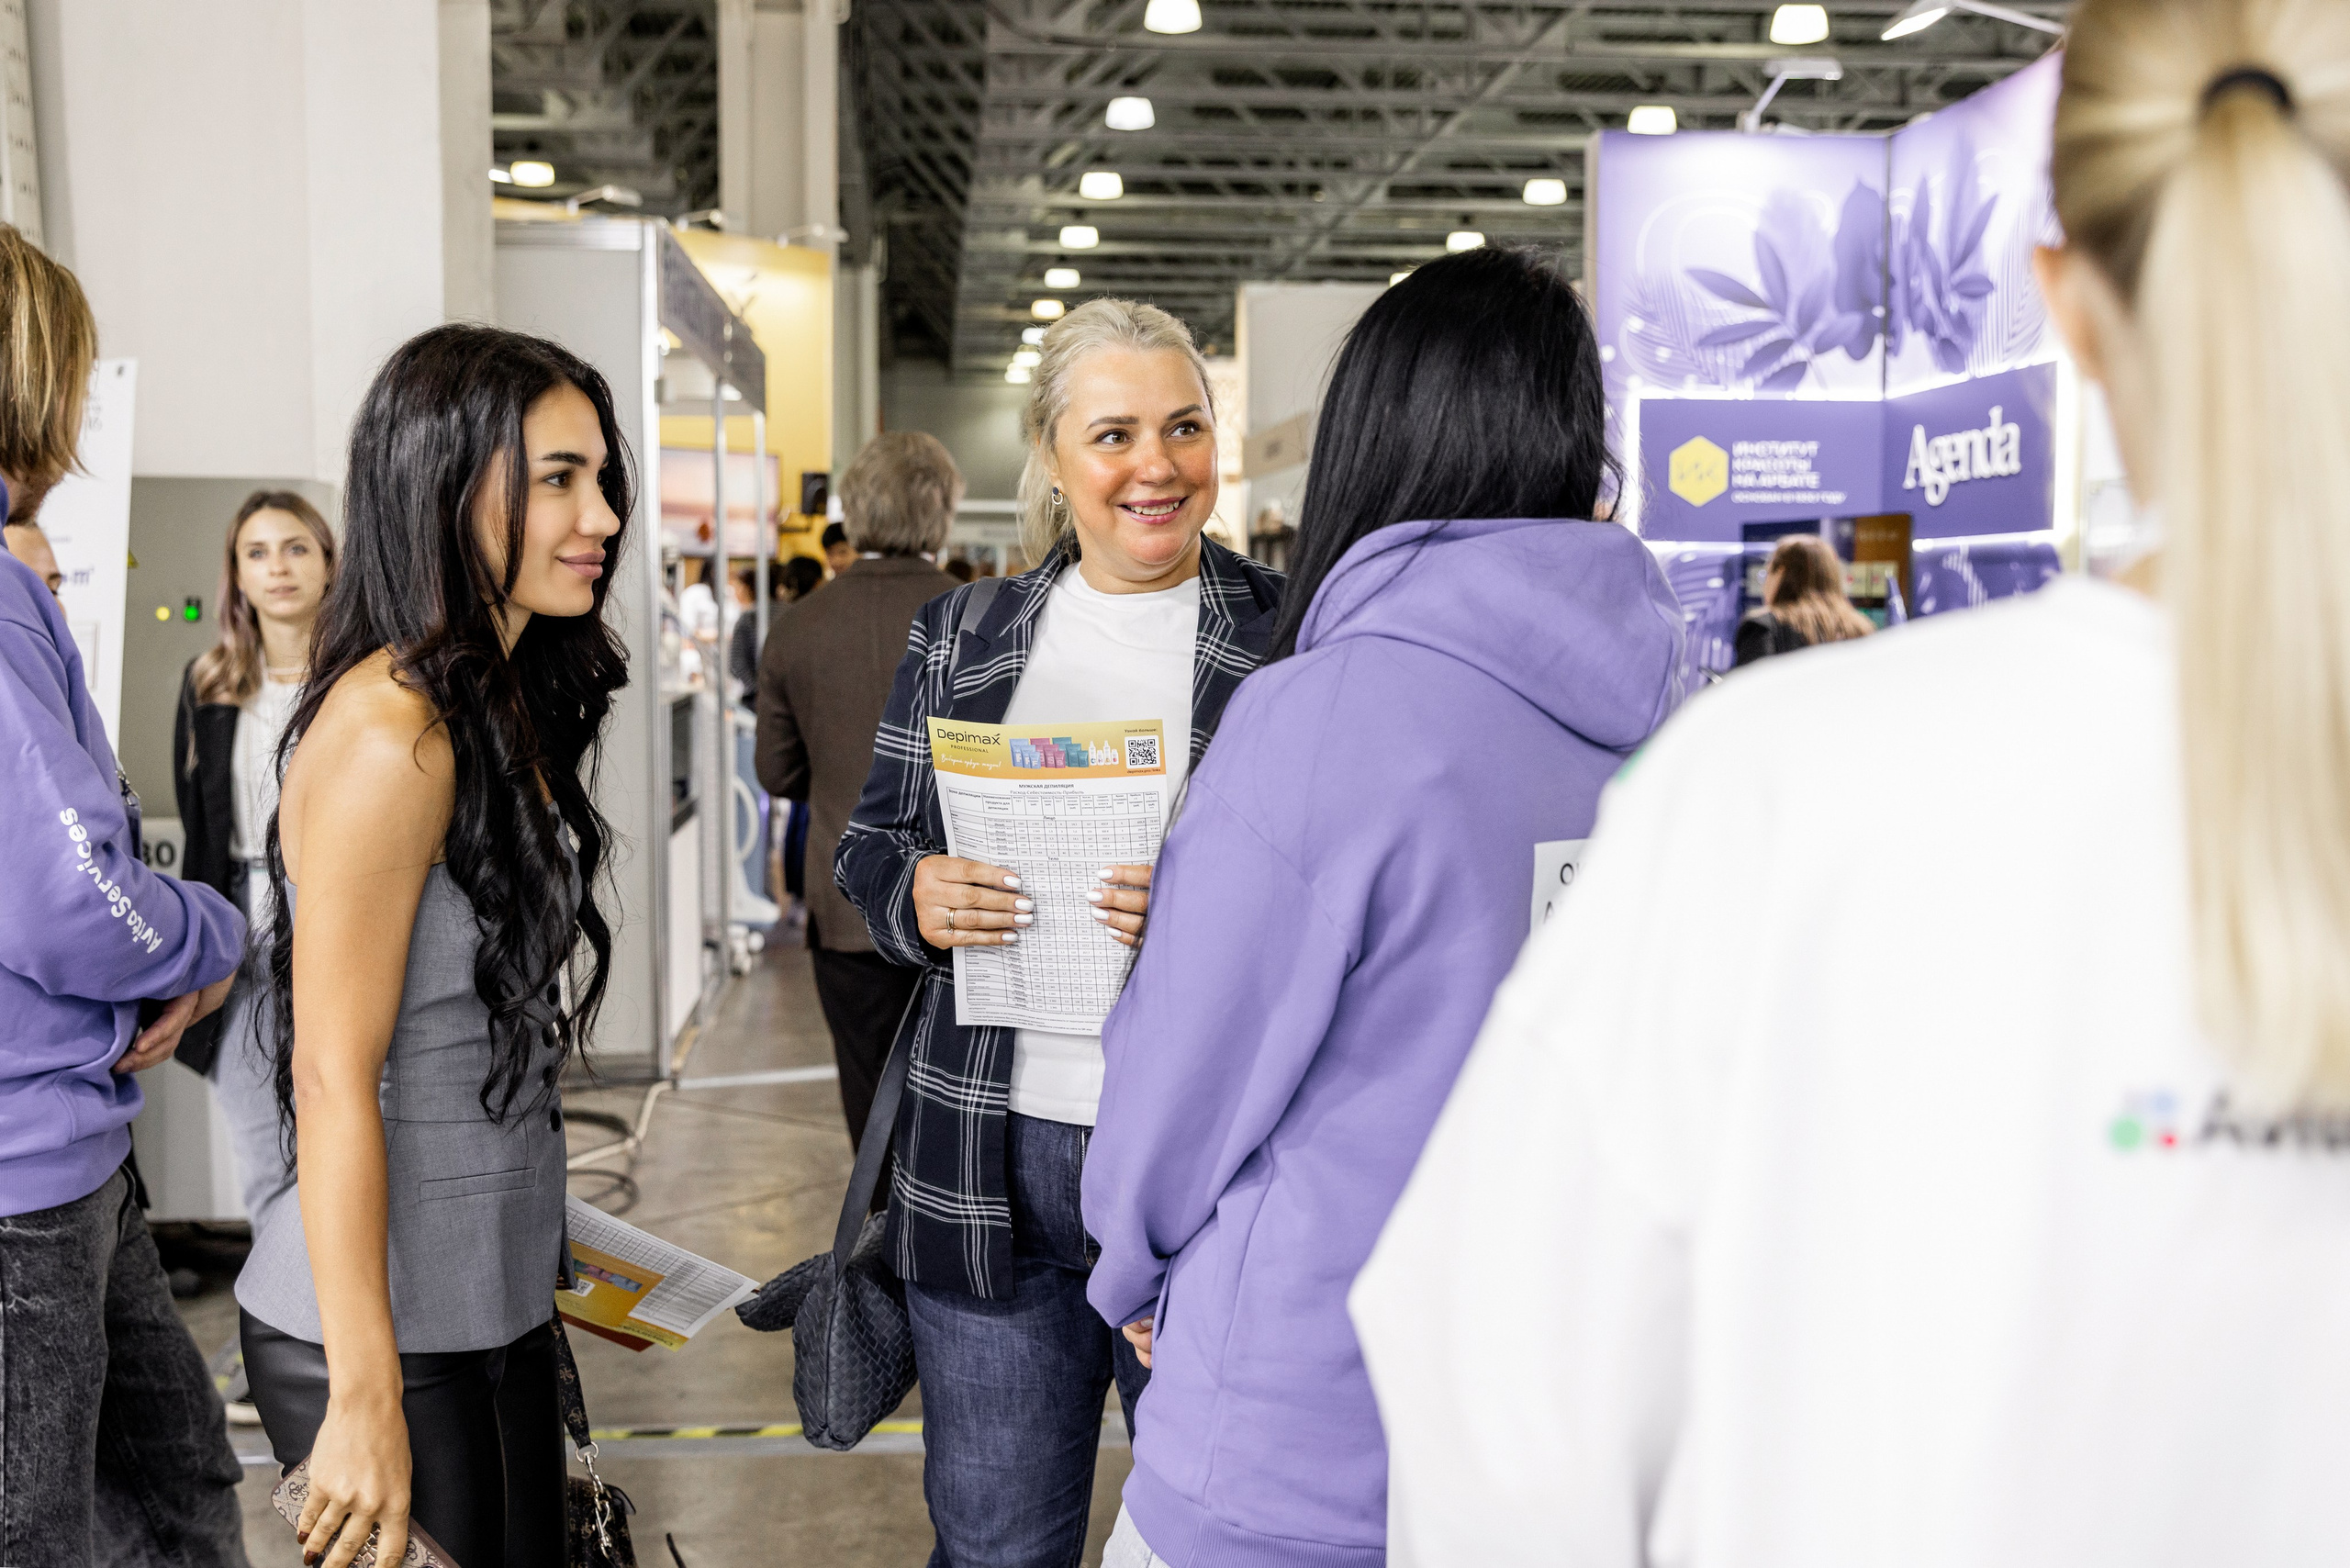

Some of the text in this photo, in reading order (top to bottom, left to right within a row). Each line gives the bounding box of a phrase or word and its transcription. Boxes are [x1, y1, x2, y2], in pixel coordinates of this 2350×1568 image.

[1902, 405, 2022, 506] Agenda
[937, 728, 1001, 745] Depimax
[950, 745, 989, 753] PROFESSIONAL
[60, 807, 163, 954] Avito Services
